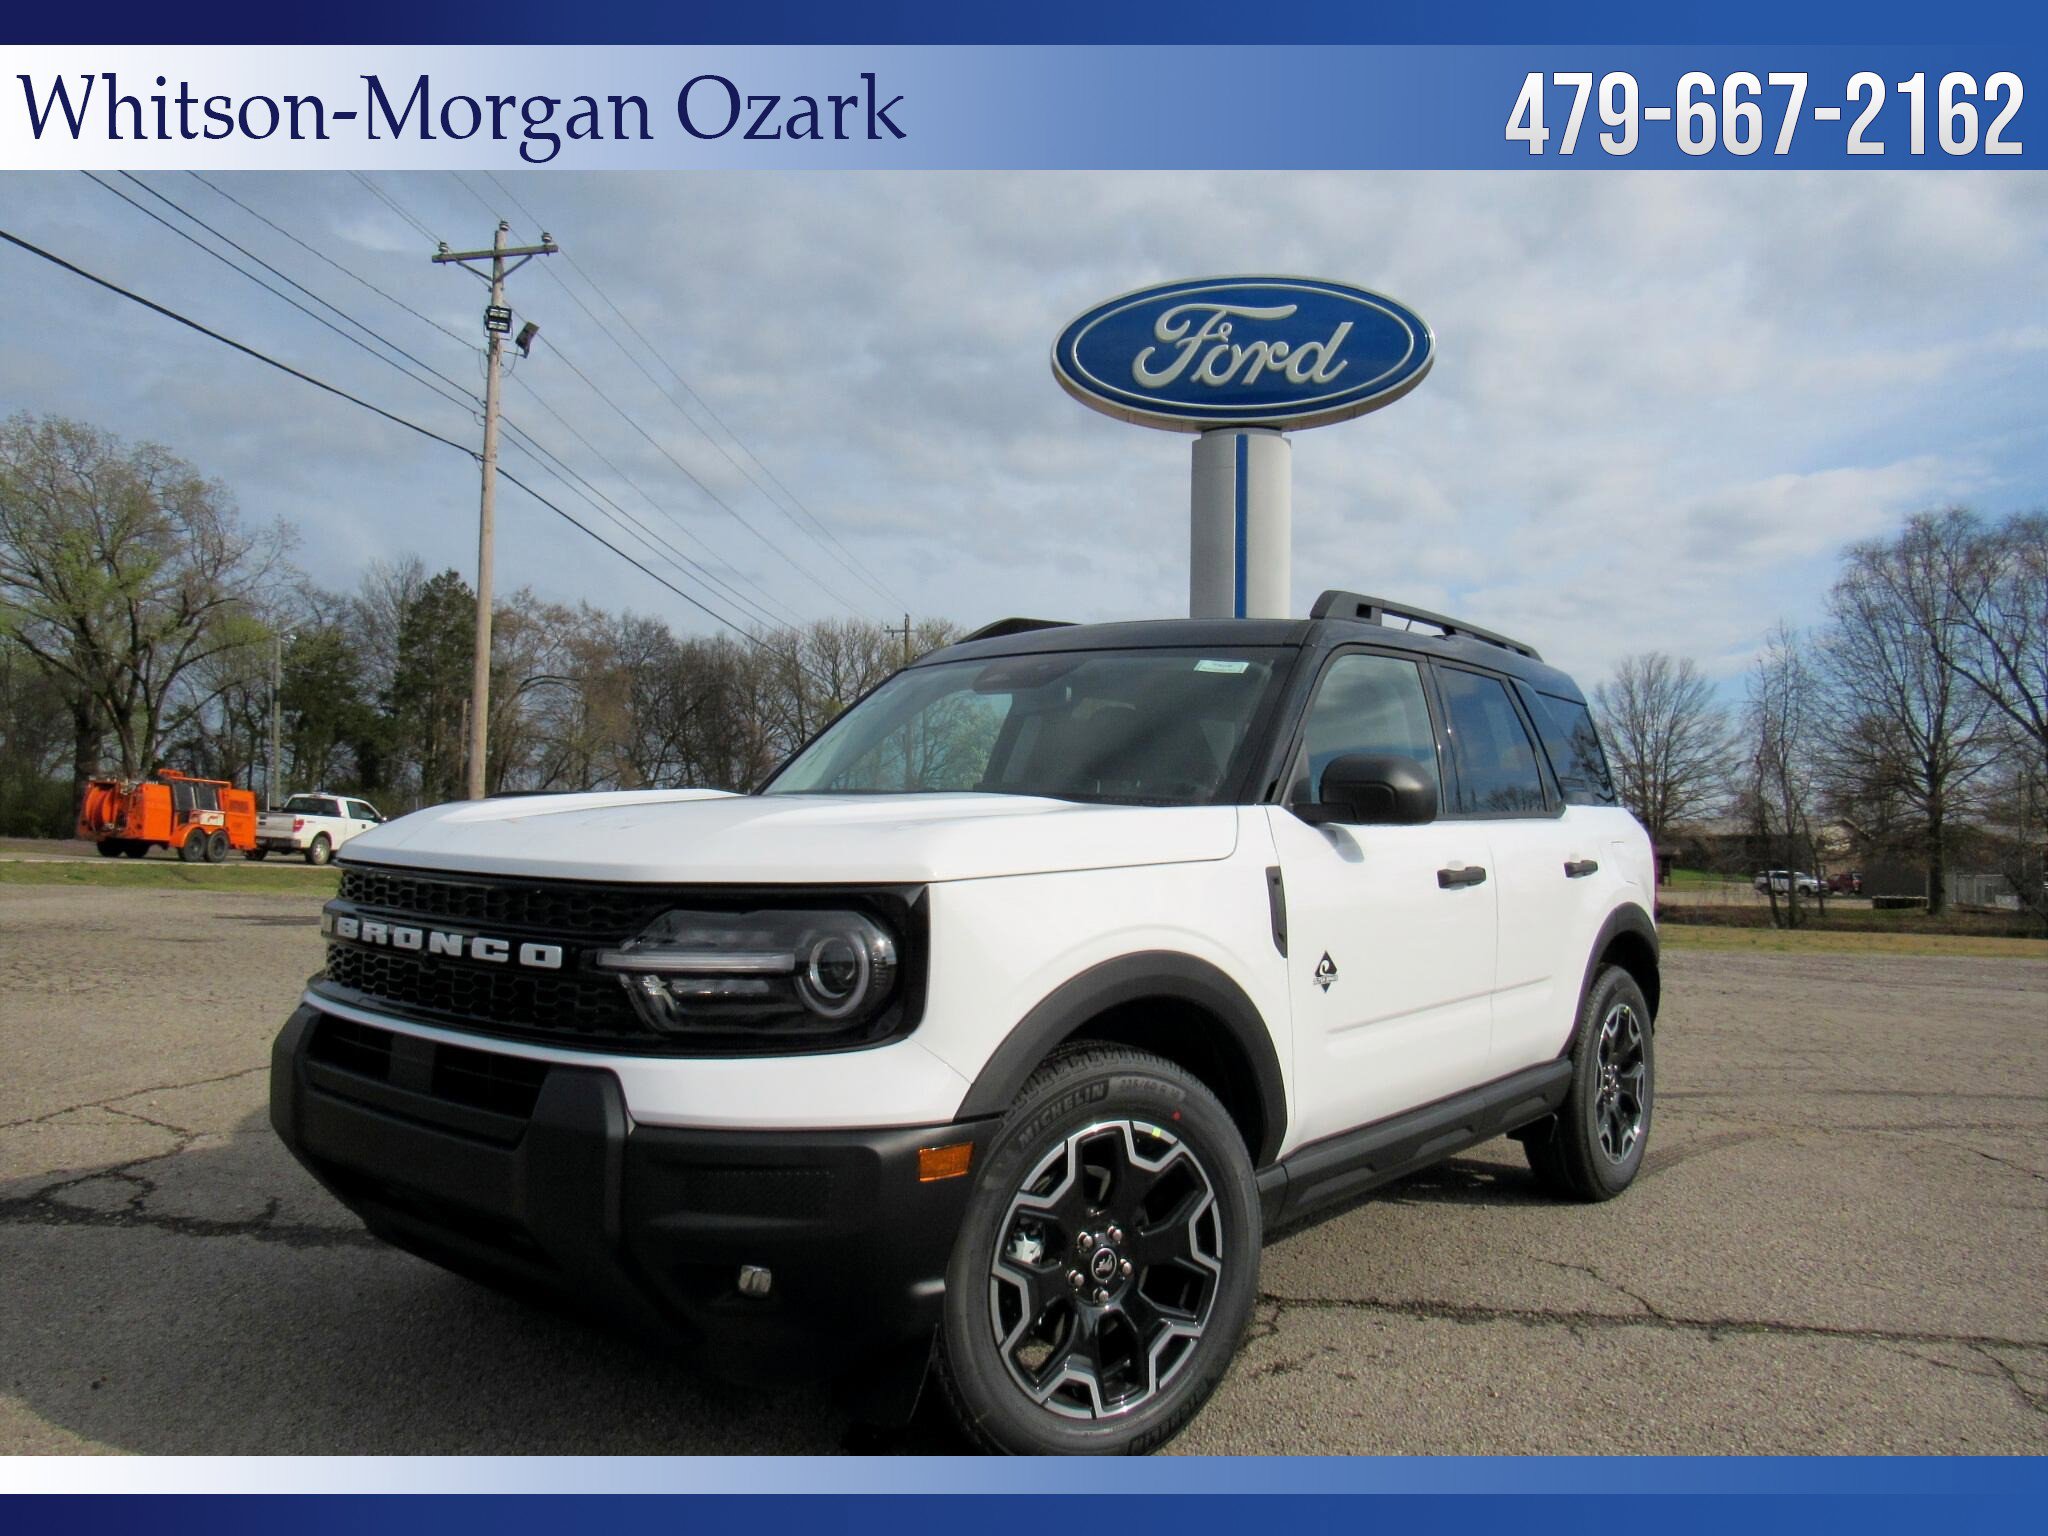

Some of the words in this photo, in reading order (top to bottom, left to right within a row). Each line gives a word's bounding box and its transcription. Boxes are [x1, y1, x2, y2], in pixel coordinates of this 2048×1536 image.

[1132, 302, 1354, 389] Ford
[336, 916, 563, 969] BRONCO
[1018, 1082, 1105, 1149] MICHELIN
